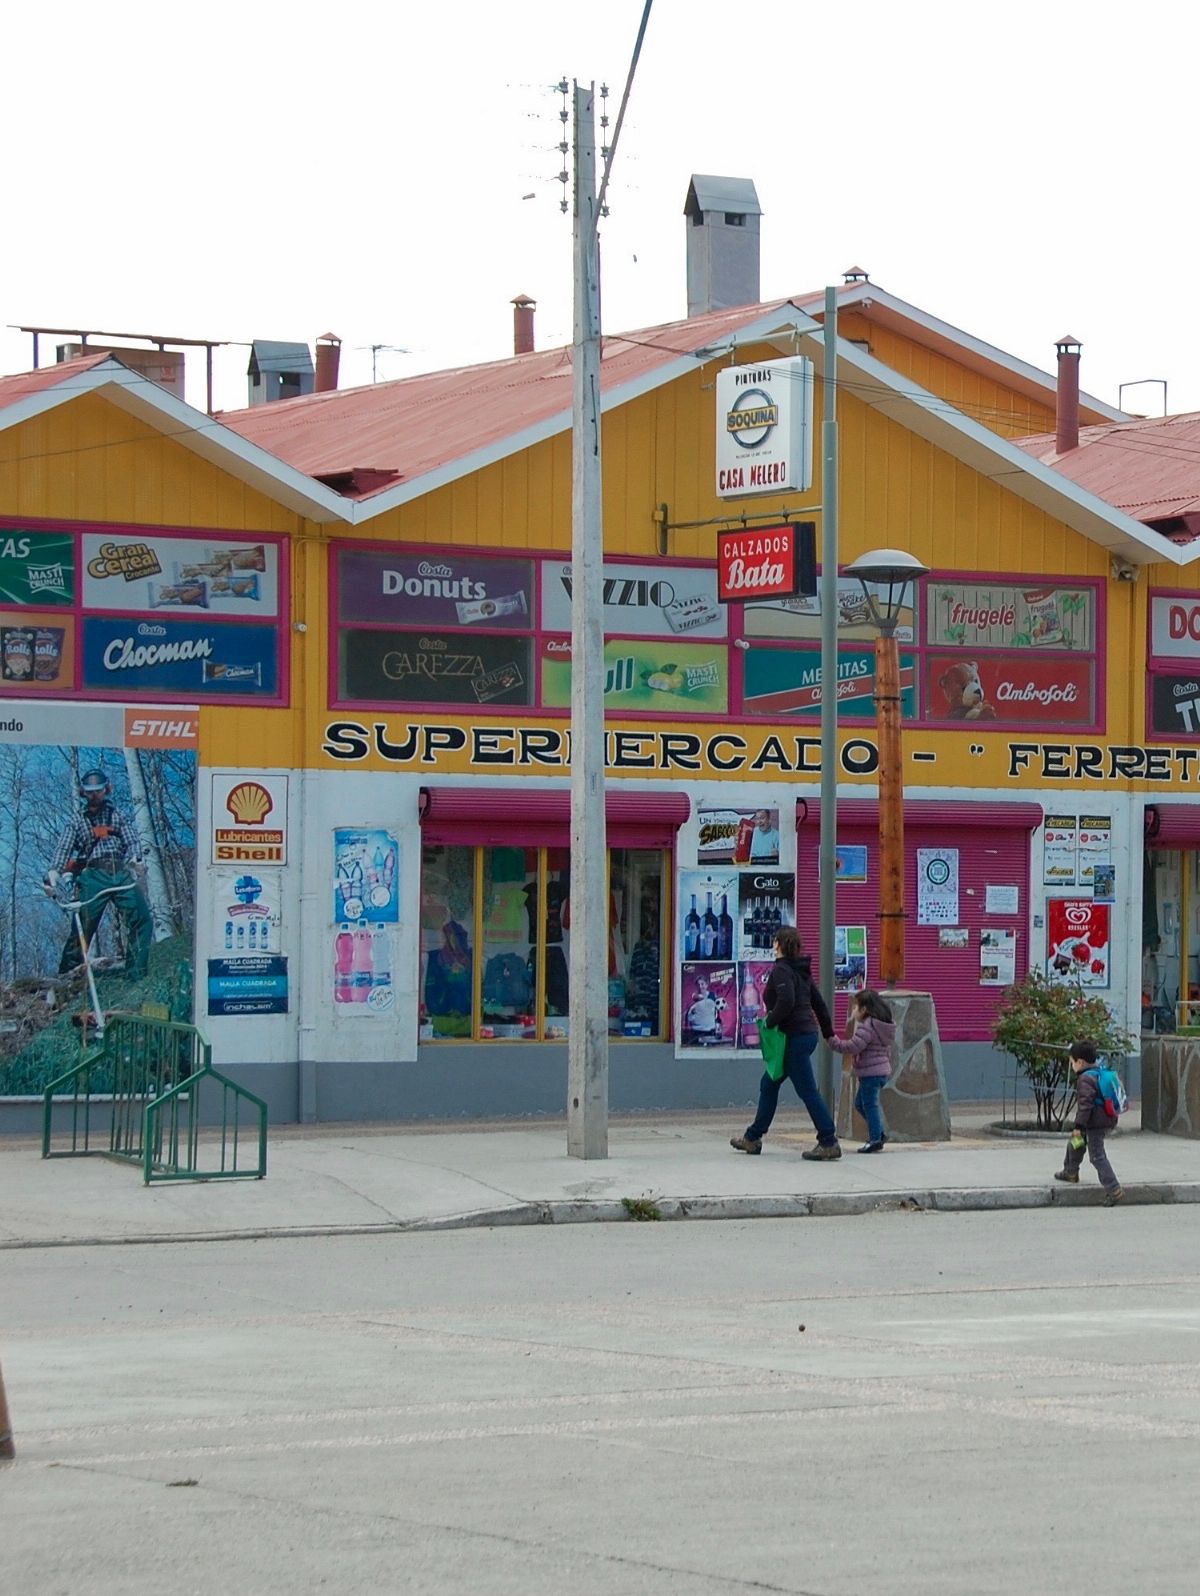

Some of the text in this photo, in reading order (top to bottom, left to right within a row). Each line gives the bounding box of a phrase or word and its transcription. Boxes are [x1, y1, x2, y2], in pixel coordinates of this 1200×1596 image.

[735, 369, 772, 386] PINTURAS
[728, 408, 775, 429] SOQUINA
[719, 461, 786, 491] CASA MELERO
[100, 543, 149, 559] Gran
[724, 535, 789, 558] CALZADOS
[88, 550, 158, 578] Cereal
[418, 561, 453, 577] Costa
[725, 556, 785, 590] Bata
[382, 570, 487, 600] Donuts
[561, 576, 675, 608] ZZIO
[952, 602, 1015, 630] frugelé
[103, 637, 212, 670] Chocman
[382, 651, 487, 681] CAREZZA
[802, 659, 868, 686] MEITAS
[996, 681, 1078, 705] Ambrosoli
[1173, 682, 1199, 697] Costa
[130, 720, 196, 738] STIHL
[217, 831, 282, 843] Lubricantes
[217, 846, 283, 861] Shell
[753, 876, 779, 889] Gato
